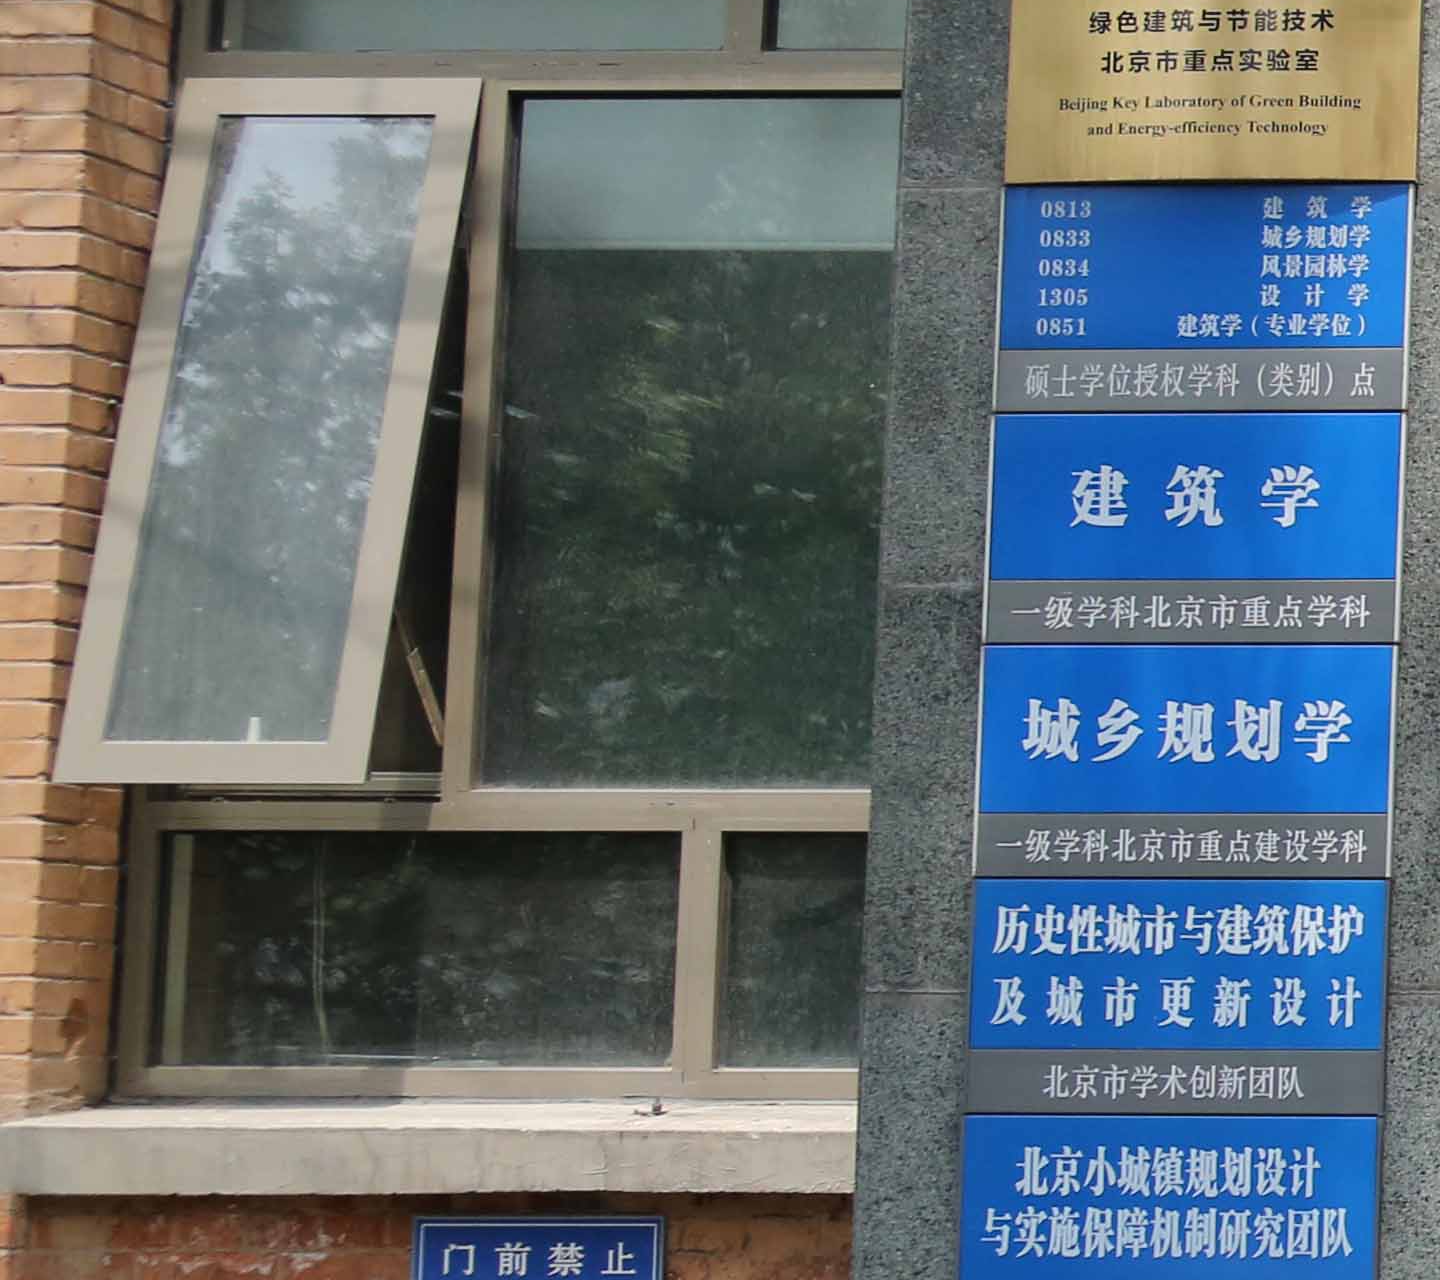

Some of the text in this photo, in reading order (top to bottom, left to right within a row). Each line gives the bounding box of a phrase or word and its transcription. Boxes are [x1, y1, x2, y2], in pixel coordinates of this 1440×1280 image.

[1088, 8, 1336, 34] 绿色建筑与节能技术
[1100, 48, 1320, 74] 北京市重点实验室
[1058, 94, 1361, 113] Beijing Key Laboratory of Green Building
[1087, 120, 1329, 137] and Energy-efficiency Technology
[1040, 196, 1373, 220] 0813 建筑学
[1039, 224, 1371, 249] 0833 城乡规划学
[1038, 254, 1370, 280] 0834 风景园林学
[1037, 283, 1370, 308] 1305 设计学
[1035, 315, 1367, 338] 0851 建筑学（专业学位）
[1024, 361, 1376, 400] 硕士学位授权学科（类别）点
[1069, 464, 1321, 528] 建筑学
[1010, 593, 1371, 630] 一级学科北京市重点学科
[1021, 697, 1353, 763] 城乡规划学
[995, 827, 1368, 864] 一级学科北京市重点建设学科
[993, 903, 1365, 957] 历史性城市与建筑保护
[990, 976, 1363, 1028] 及城市更新设计
[1042, 1063, 1305, 1100] 北京市学术创新团队
[1015, 1145, 1322, 1199] 北京小城镇规划设计
[980, 1206, 1354, 1259] 与实施保障机制研究团队
[441, 1241, 638, 1277] 门前禁止
